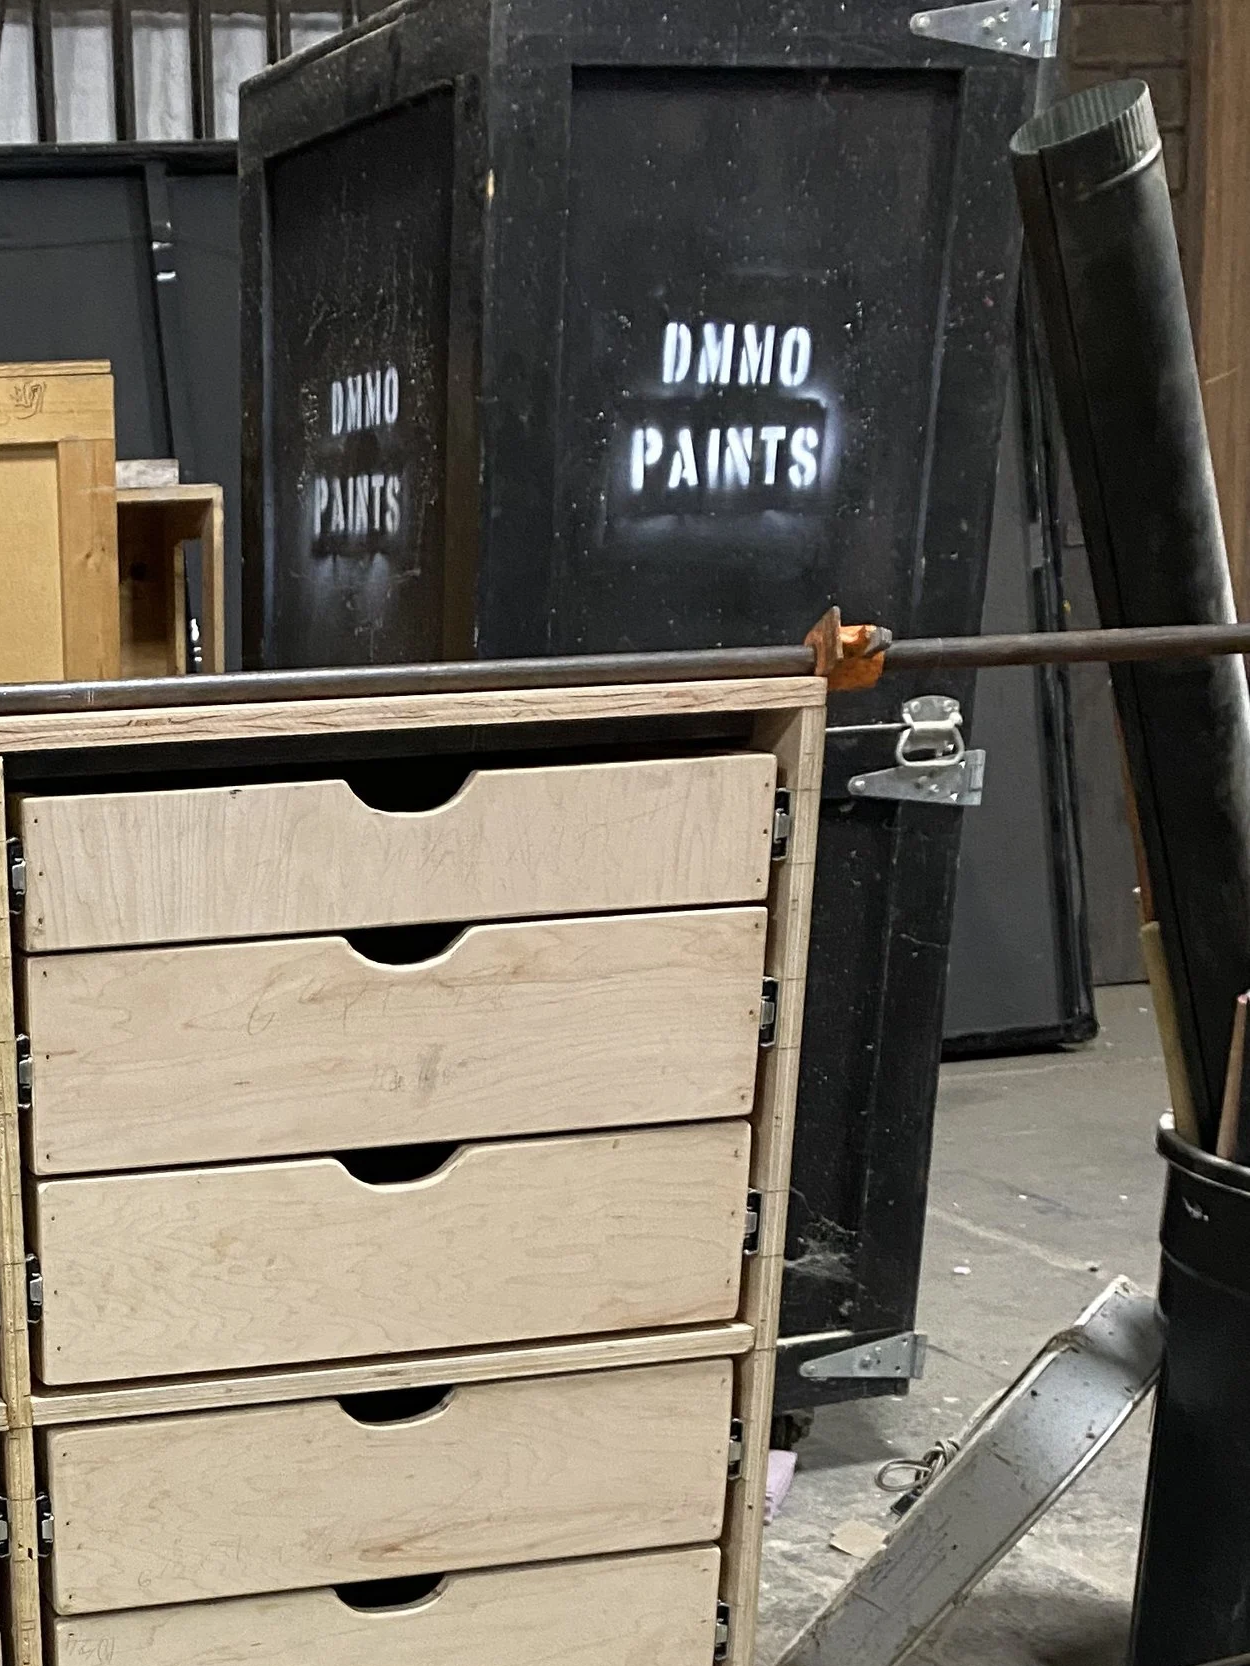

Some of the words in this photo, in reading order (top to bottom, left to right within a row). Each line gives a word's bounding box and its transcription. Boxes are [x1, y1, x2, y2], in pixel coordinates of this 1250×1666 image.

[662, 322, 811, 387] DMMO
[331, 366, 399, 436] DMMO
[630, 425, 820, 490] PAINTS
[313, 473, 401, 536] PAINTS
